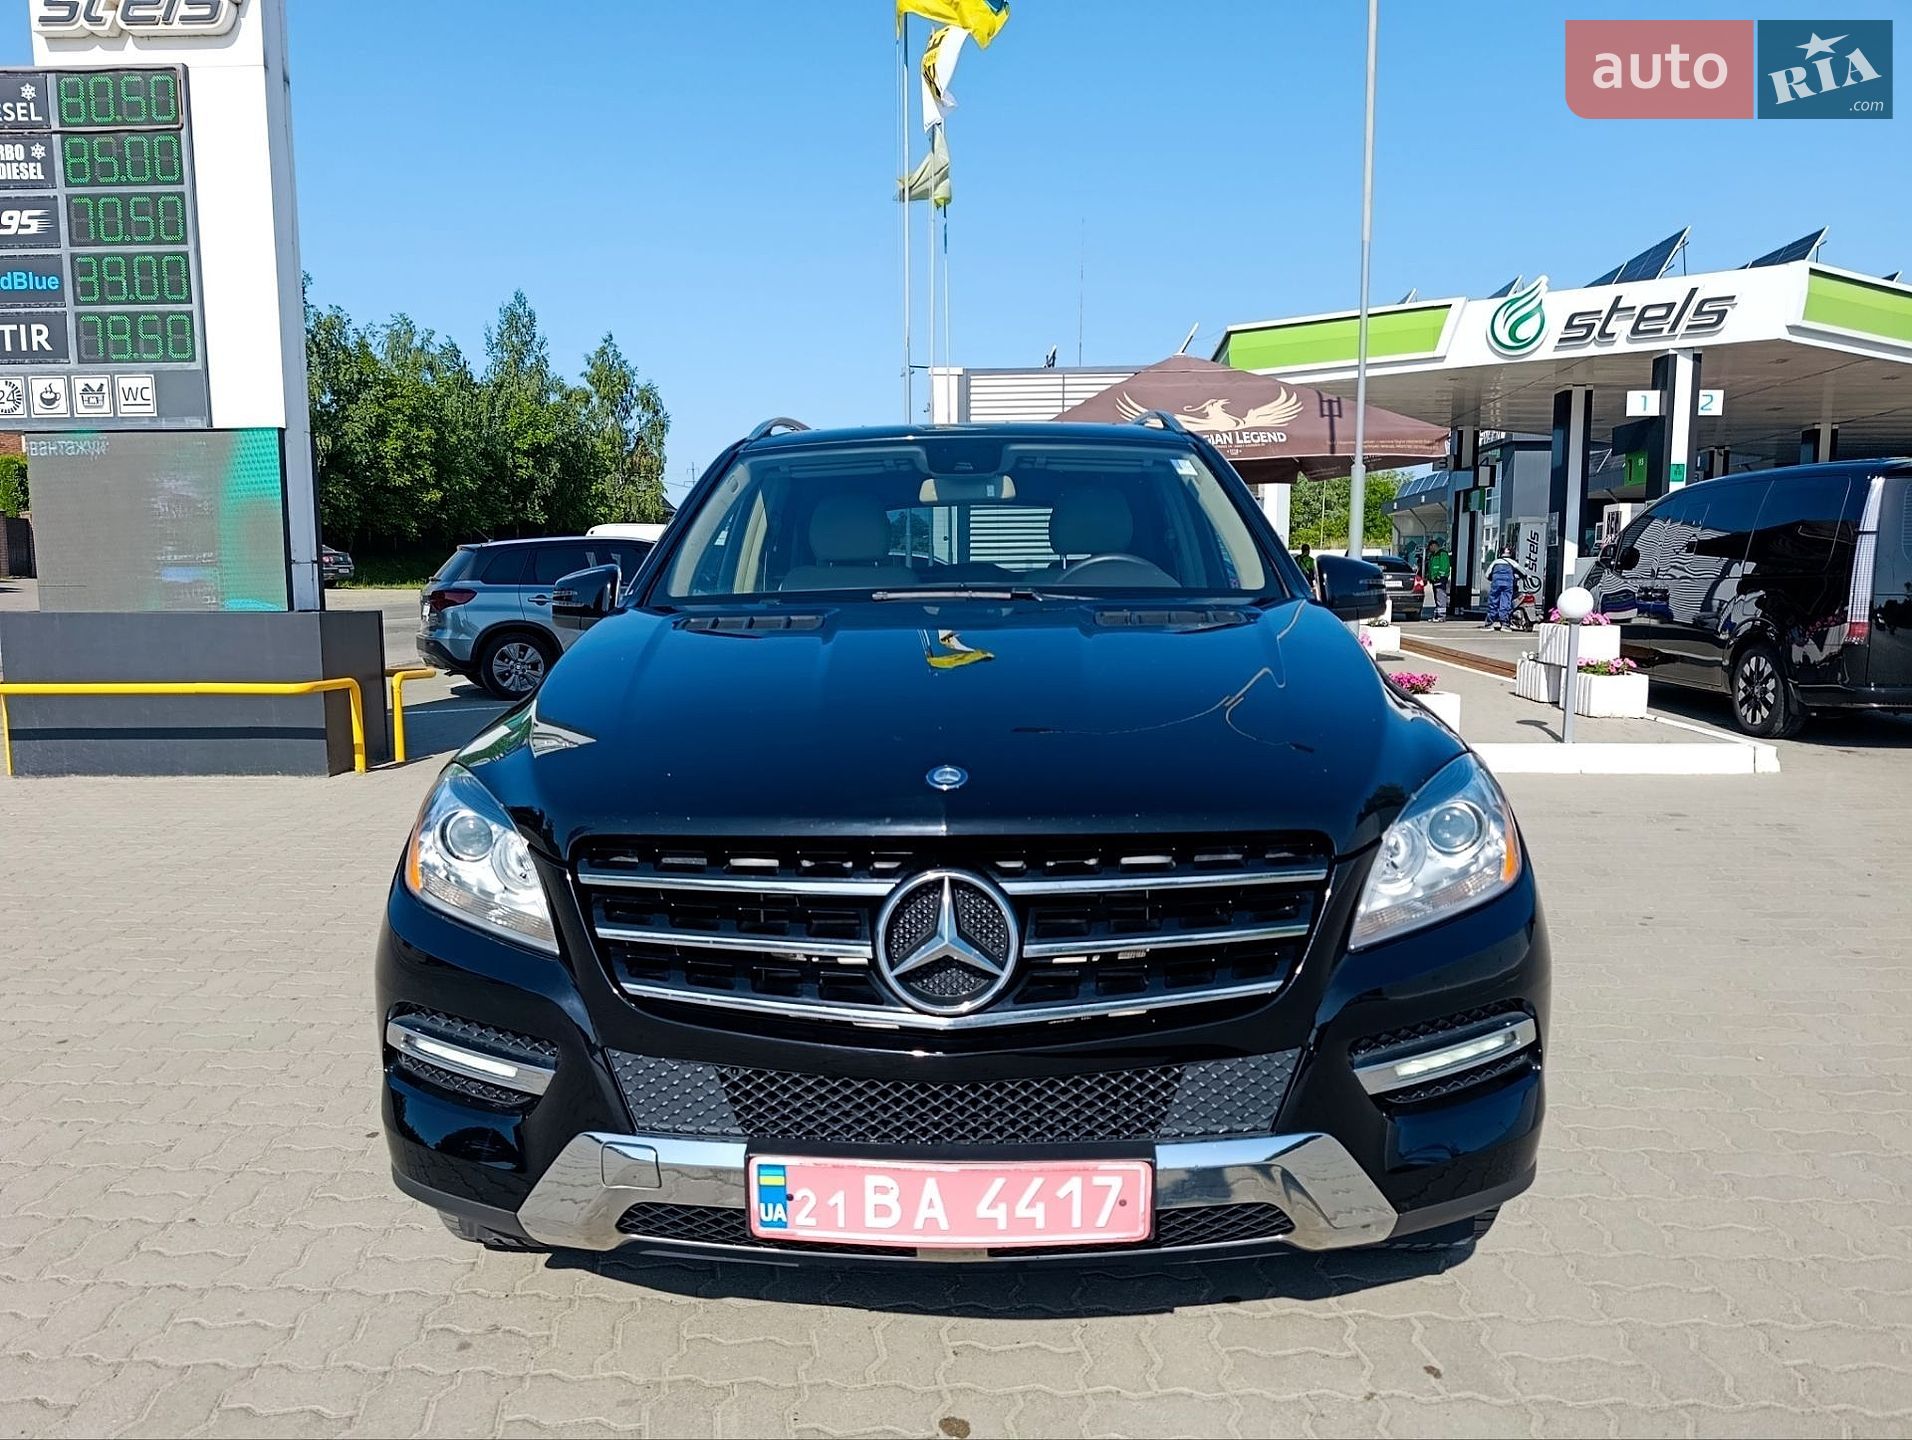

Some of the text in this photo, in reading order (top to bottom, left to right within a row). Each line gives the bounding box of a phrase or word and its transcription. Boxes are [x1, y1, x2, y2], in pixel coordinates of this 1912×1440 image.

[0, 102, 43, 121] SEL
[0, 271, 60, 291] dBlue
[1556, 286, 1738, 347] stels
[0, 323, 53, 352] TIR
[121, 386, 151, 402] WC
[1640, 395, 1648, 412] 1
[1700, 394, 1714, 411] 2
[1235, 431, 1287, 444] LEGEND
[1525, 529, 1540, 573] stels
[795, 1174, 1123, 1231] 21 BA 4417
[760, 1203, 788, 1222] UA
